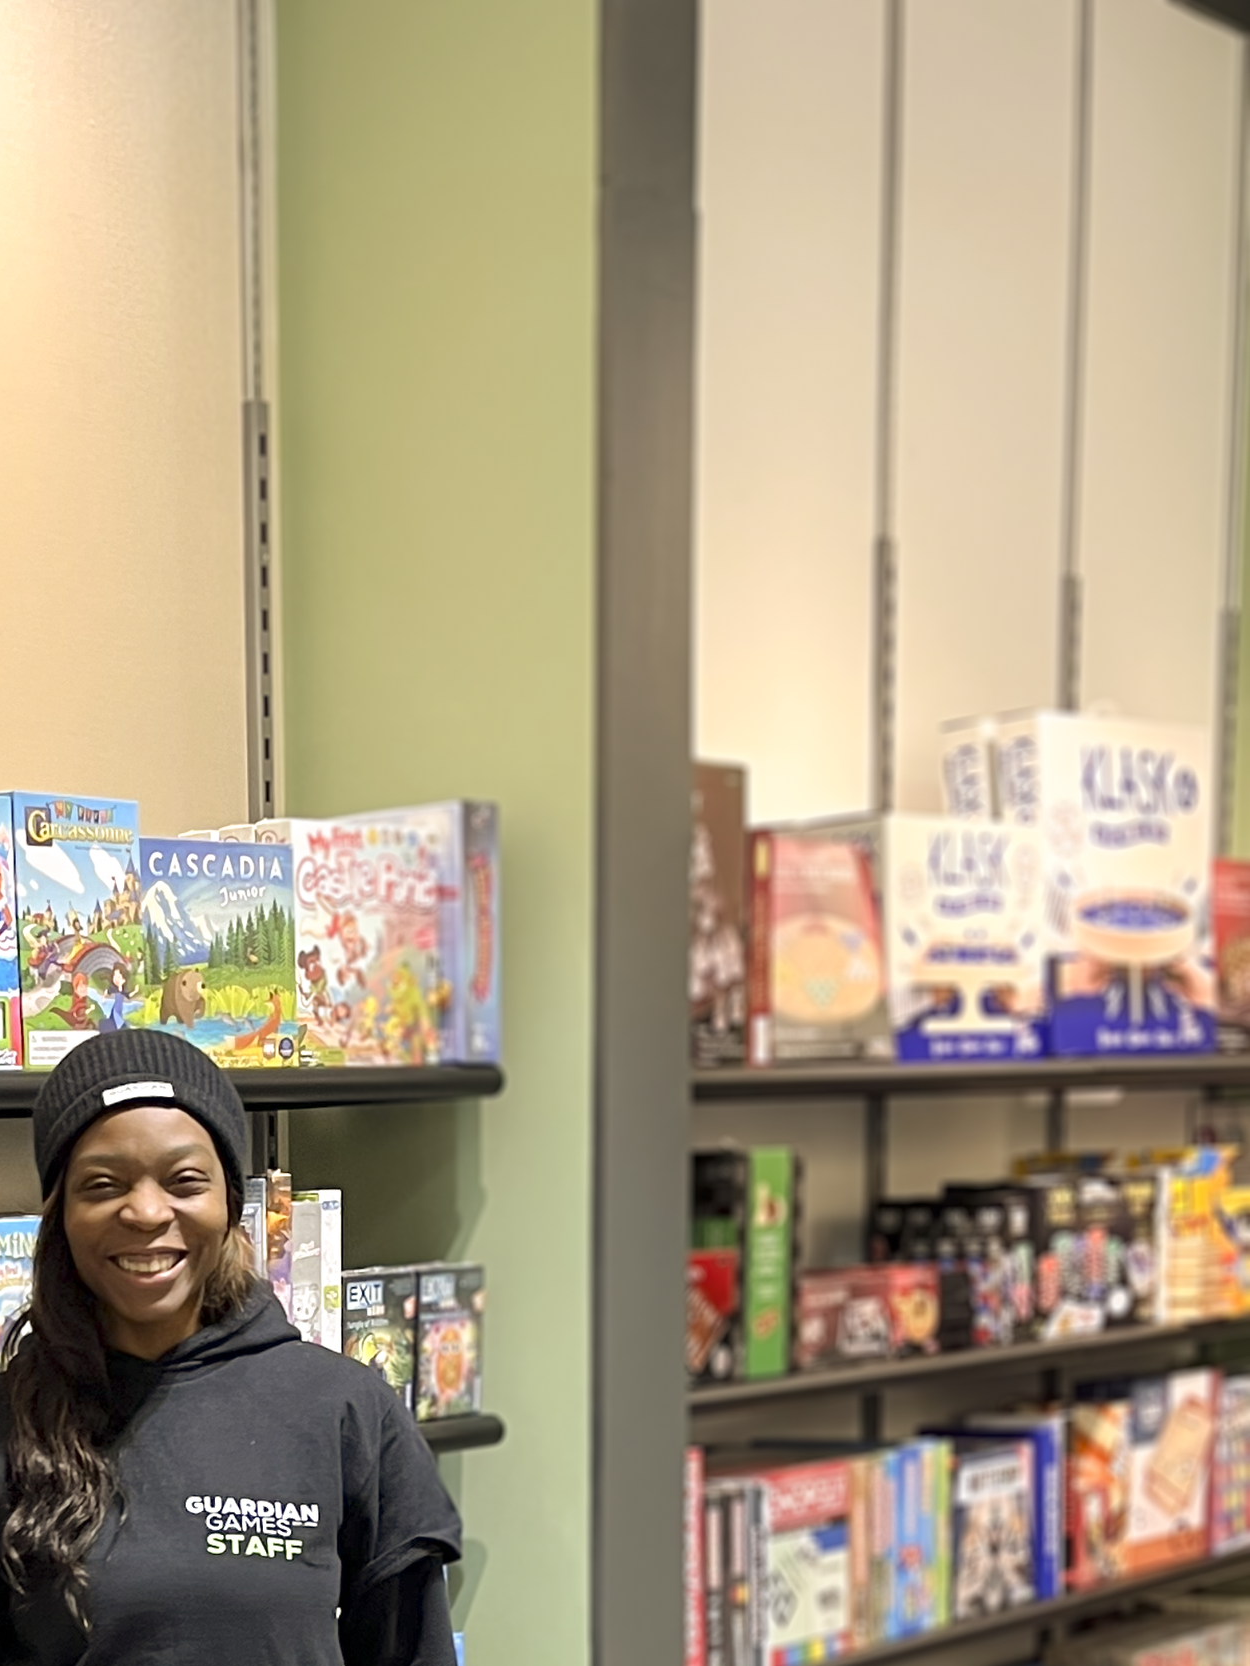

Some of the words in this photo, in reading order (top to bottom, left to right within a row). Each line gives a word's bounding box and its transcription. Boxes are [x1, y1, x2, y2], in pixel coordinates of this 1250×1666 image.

[27, 809, 134, 845] Carcassonne
[148, 852, 284, 880] CASCADIA
[219, 886, 266, 907] Junior
[350, 1284, 381, 1305] EXIT
[185, 1495, 319, 1523] GUARDIAN
[205, 1513, 292, 1537] GAMES
[206, 1533, 303, 1561] STAFF
